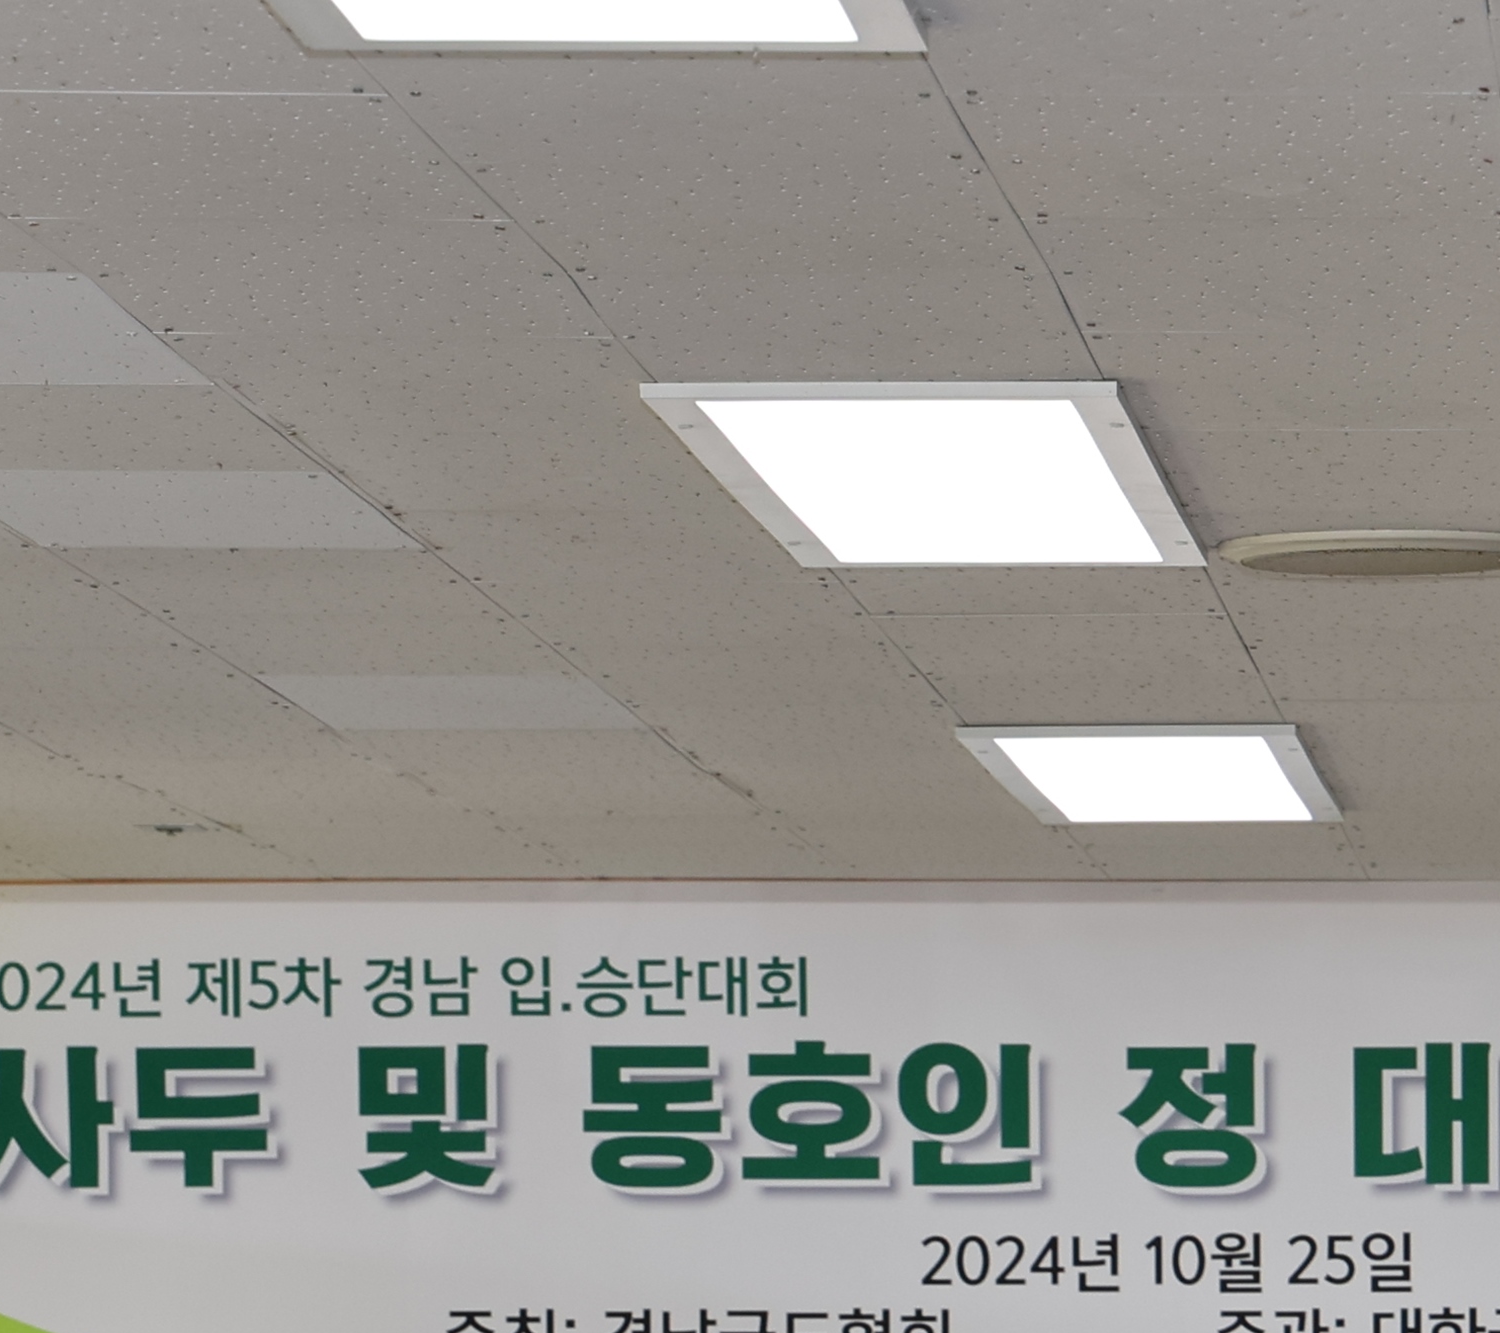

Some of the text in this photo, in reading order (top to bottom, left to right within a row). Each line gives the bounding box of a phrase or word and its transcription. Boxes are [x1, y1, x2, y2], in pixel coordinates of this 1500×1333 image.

[185, 955, 343, 1020] 제5차
[362, 954, 480, 1020] 경남
[500, 954, 810, 1020] 입.승단대회
[356, 1042, 502, 1194] 및
[580, 1038, 1036, 1194] 동호인
[1118, 1040, 1268, 1192] 정
[921, 1231, 1414, 1294] 2024년 10월 25일
